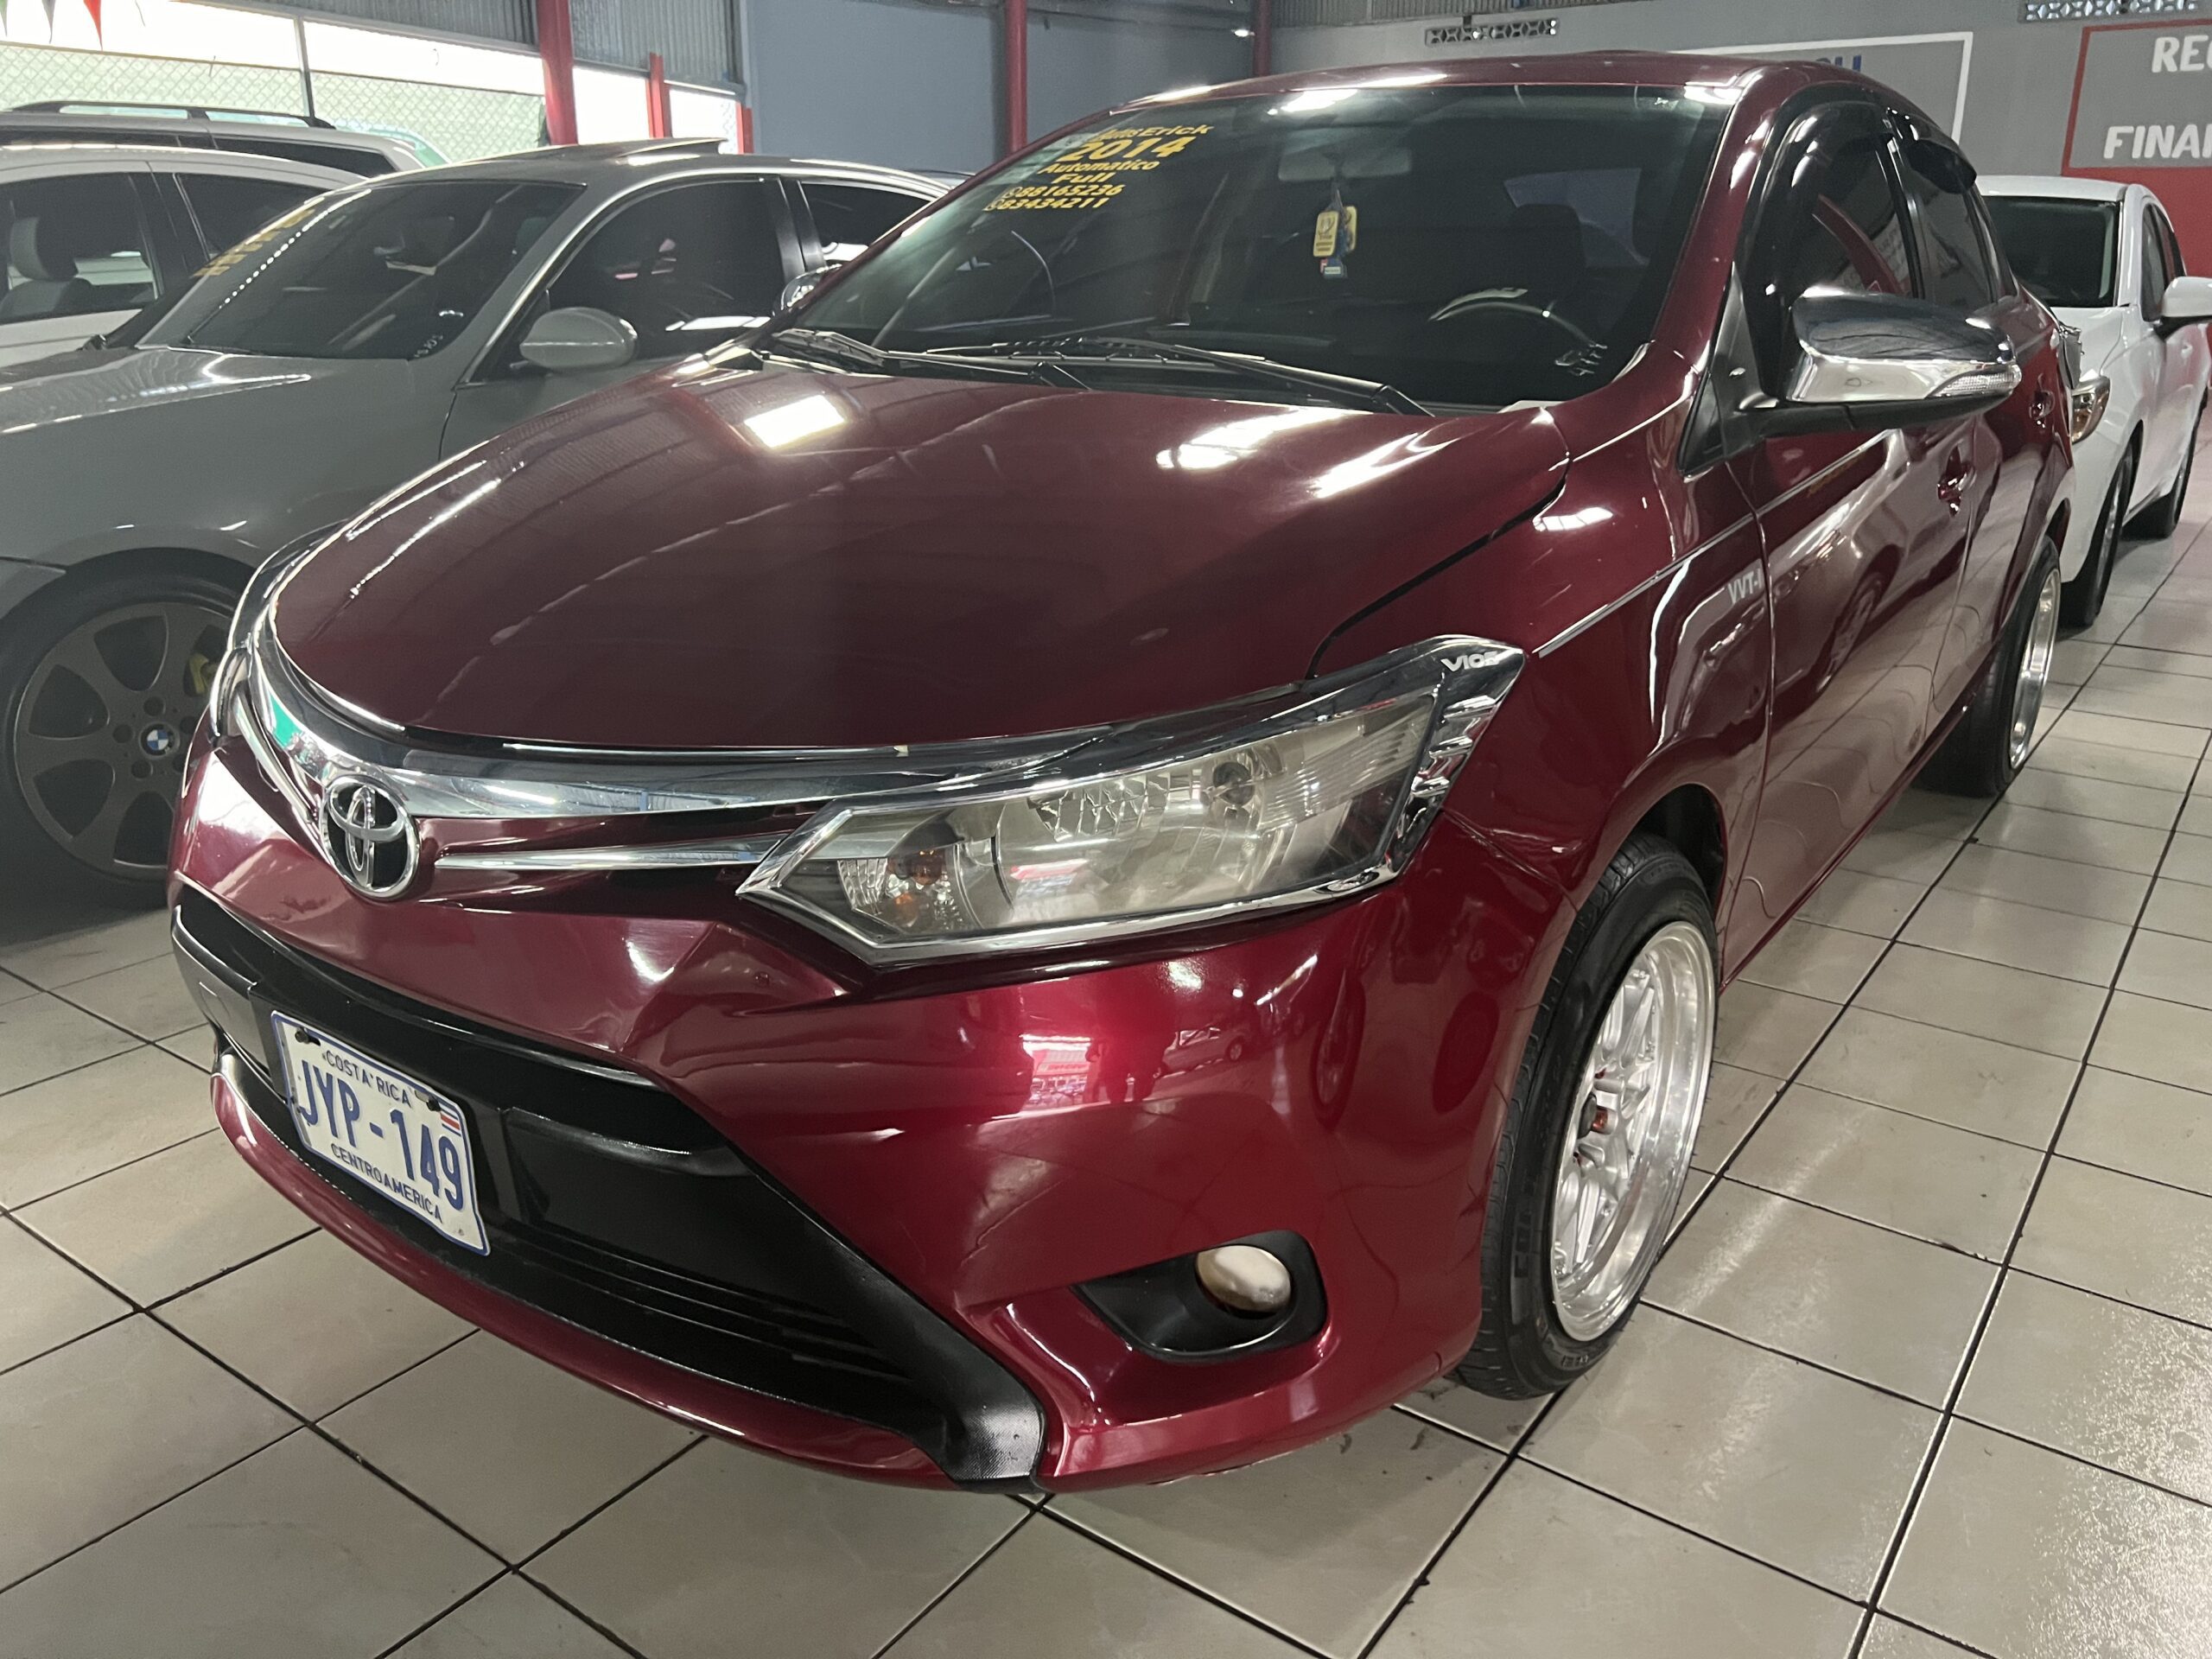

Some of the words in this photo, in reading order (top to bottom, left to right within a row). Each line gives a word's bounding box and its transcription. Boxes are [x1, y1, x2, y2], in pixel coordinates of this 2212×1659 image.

[2152, 35, 2212, 73] RE
[1057, 137, 1196, 162] 2014
[1037, 159, 1160, 174] Automatico
[1052, 173, 1116, 183] Full
[1015, 185, 1126, 197] 88165236
[326, 1050, 372, 1084] COSTA
[376, 1077, 411, 1108] RICA
[299, 1060, 464, 1210] JYP-149
[331, 1143, 443, 1224] CENTROAMERICA
